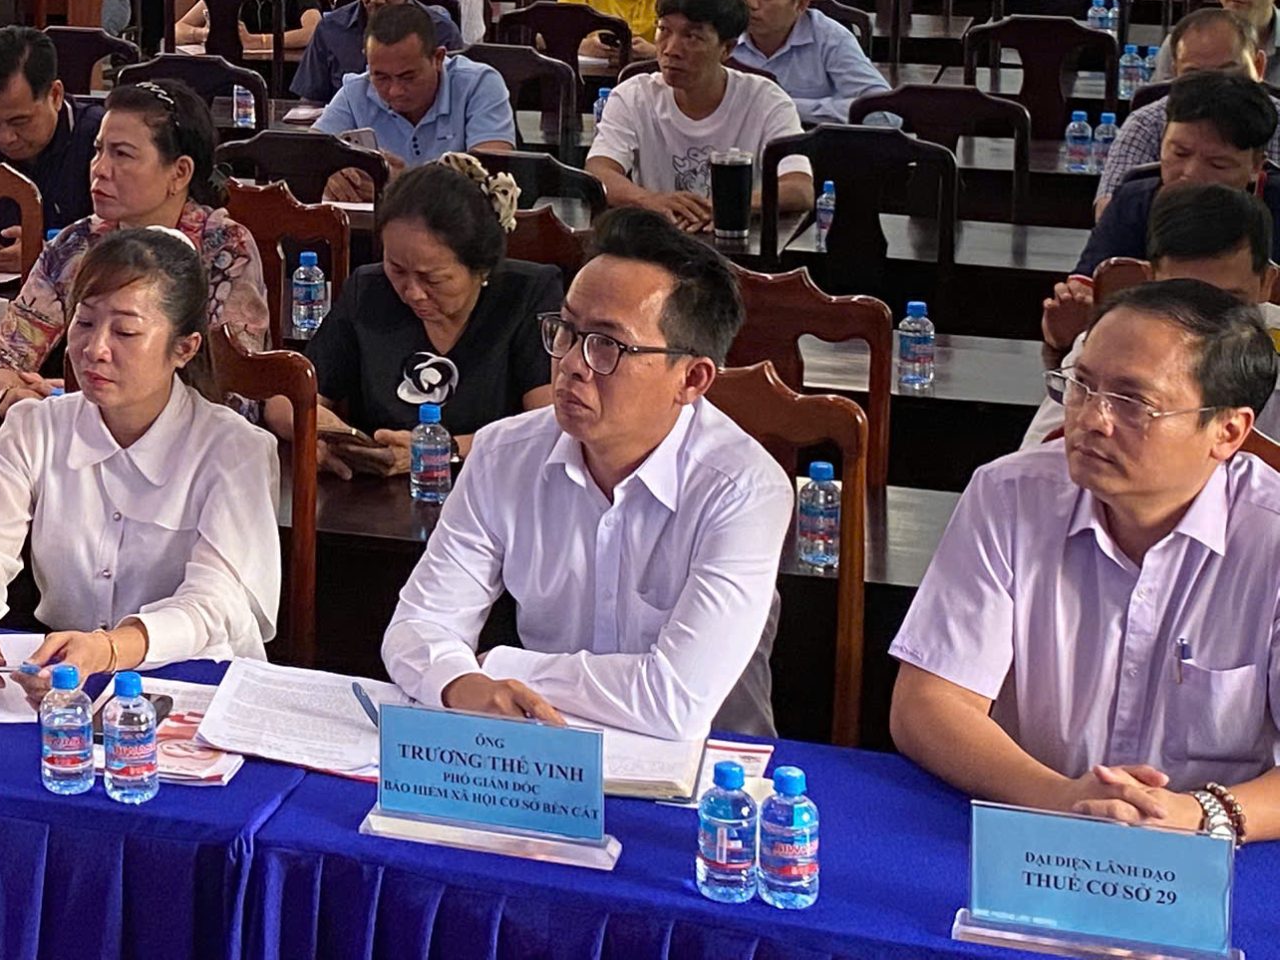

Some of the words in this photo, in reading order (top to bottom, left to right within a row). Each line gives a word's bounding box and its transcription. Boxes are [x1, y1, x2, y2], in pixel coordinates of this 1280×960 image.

[475, 733, 504, 748] ÔNG
[398, 743, 482, 768] TRƯƠNG
[487, 755, 529, 775] THẾ
[534, 761, 583, 782] VINH
[443, 771, 470, 785] PHÓ
[1055, 855, 1091, 871] DIỆN
[1096, 860, 1138, 877] LÃNH
[1022, 870, 1081, 892] THUẾ
[1086, 879, 1119, 897] CƠ
[1122, 882, 1152, 902] SỞ
[1155, 889, 1177, 905] 29
